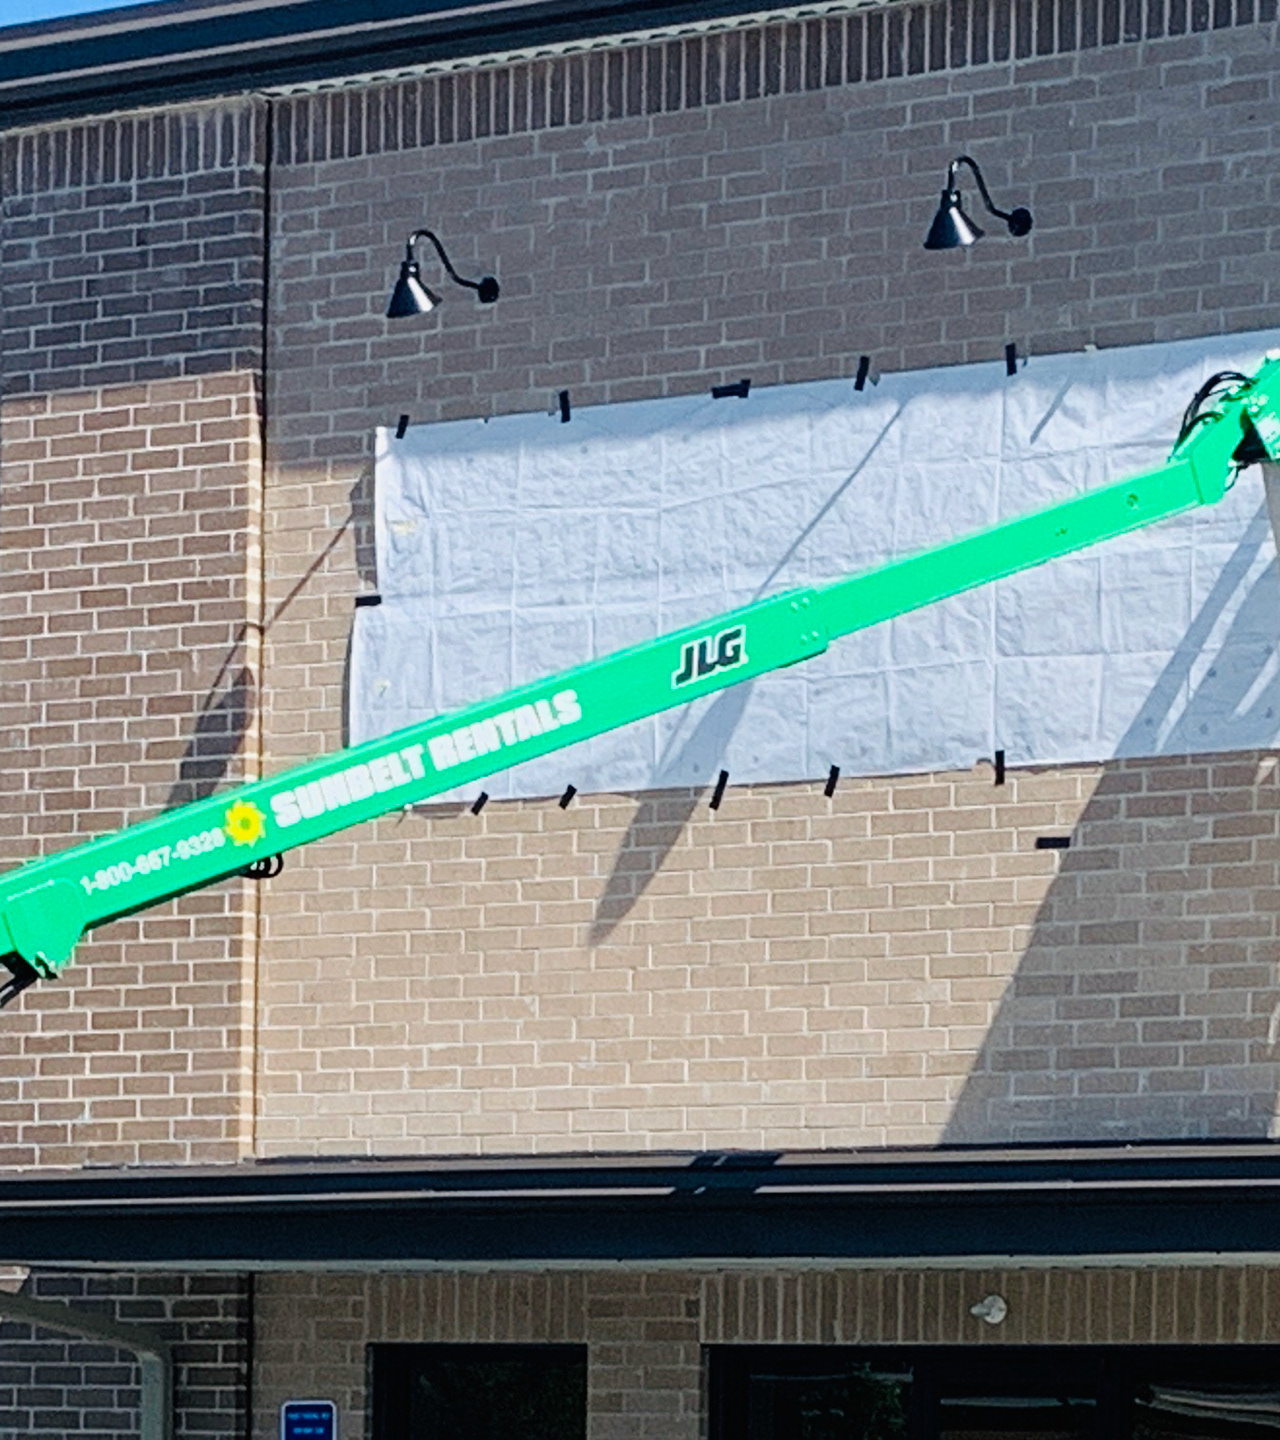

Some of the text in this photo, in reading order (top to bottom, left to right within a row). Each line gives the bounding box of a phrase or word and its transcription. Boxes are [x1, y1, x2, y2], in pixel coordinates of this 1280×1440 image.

[673, 626, 744, 688] JLG
[270, 689, 583, 828] SUNBELT RENTALS
